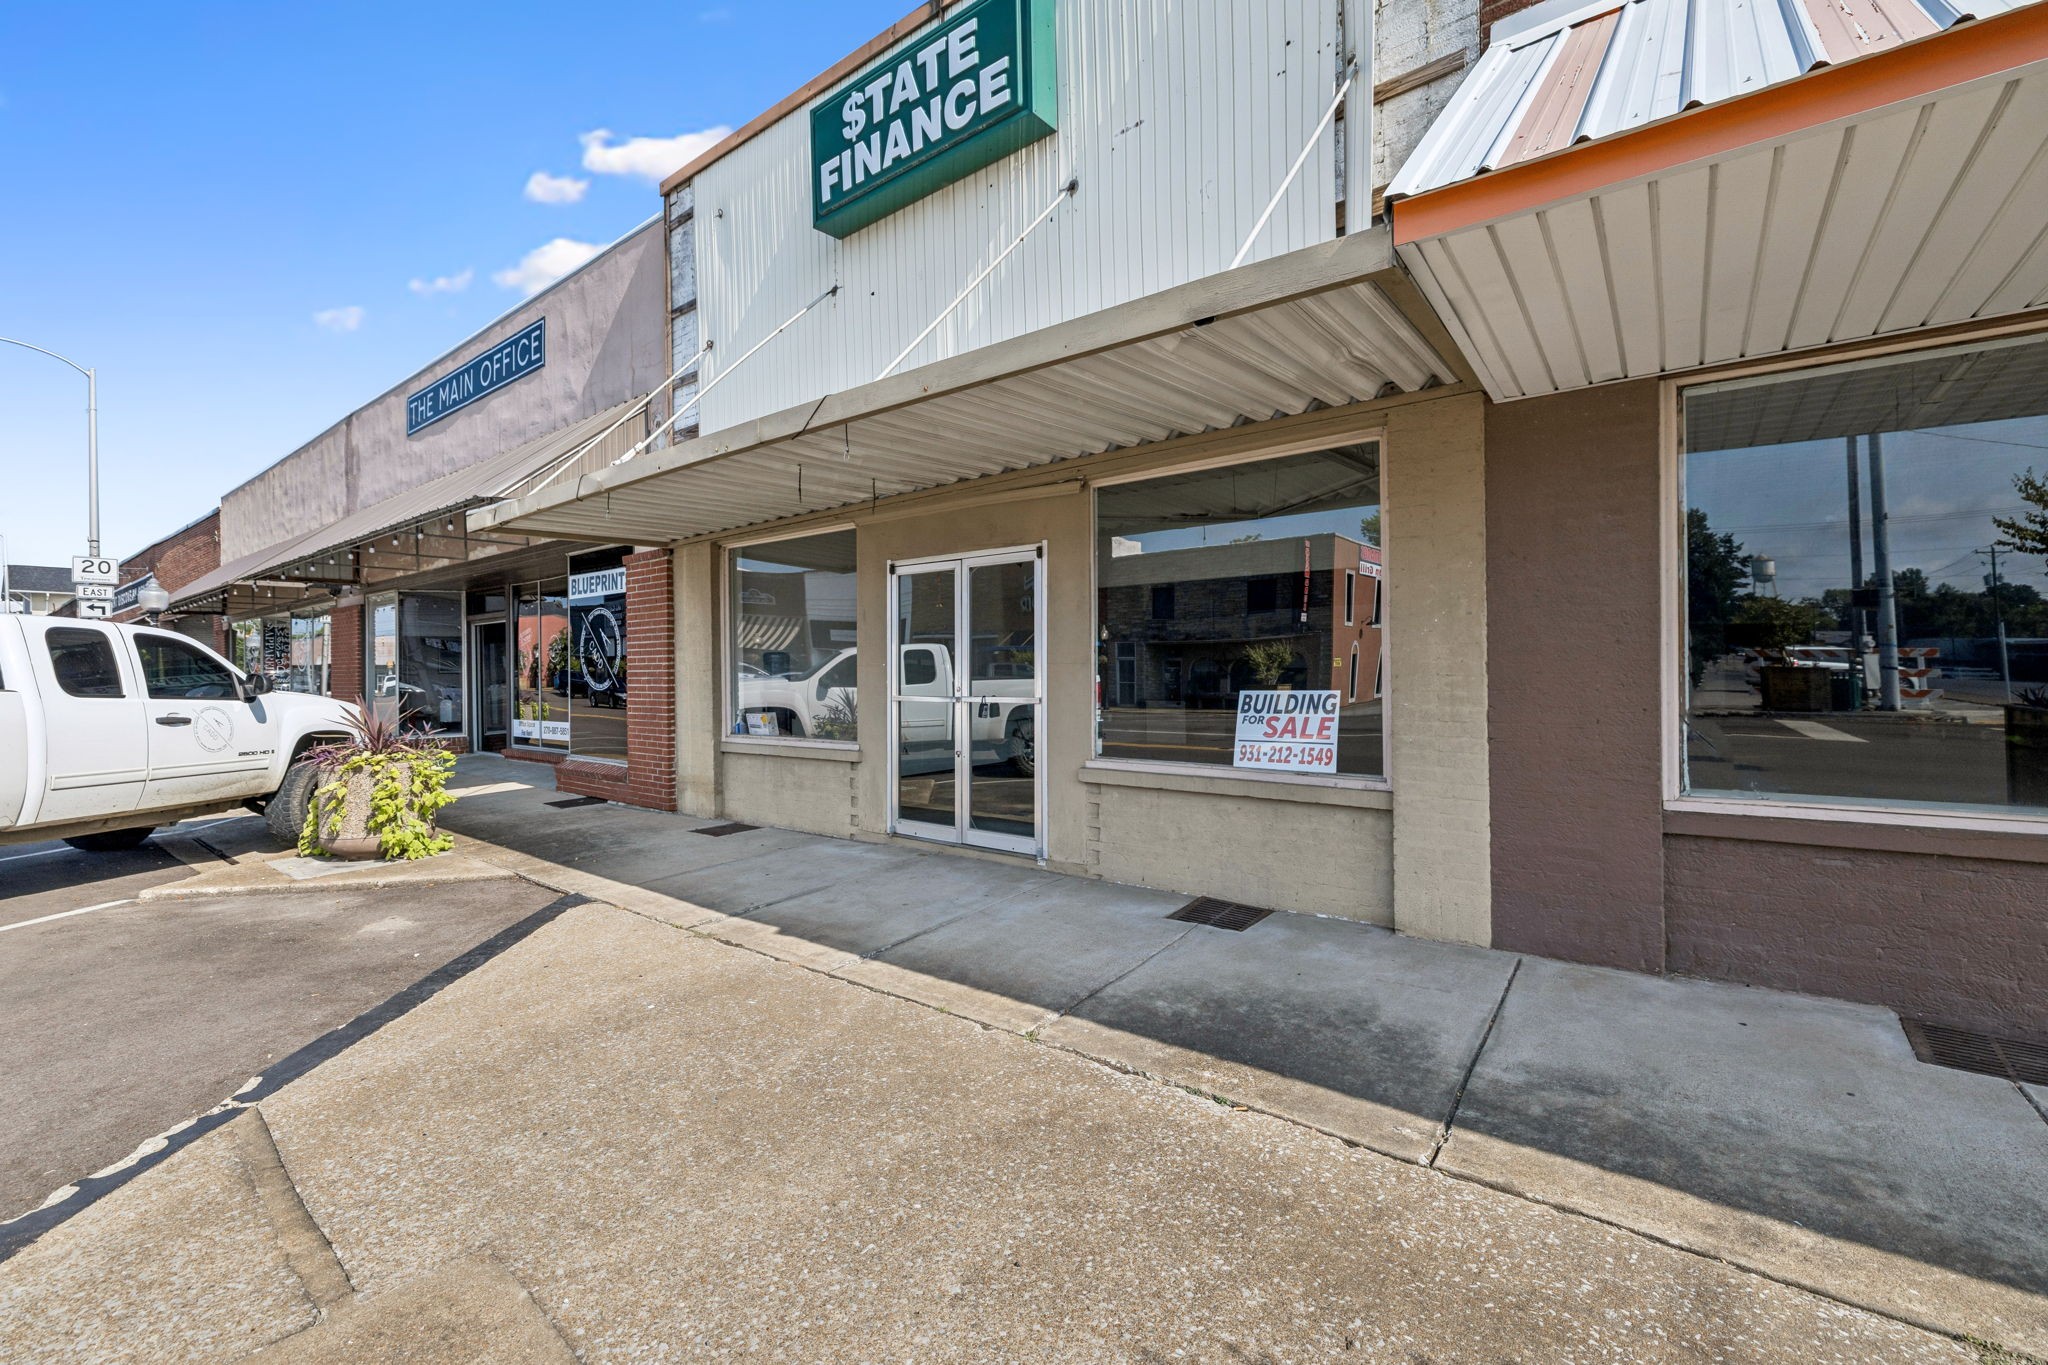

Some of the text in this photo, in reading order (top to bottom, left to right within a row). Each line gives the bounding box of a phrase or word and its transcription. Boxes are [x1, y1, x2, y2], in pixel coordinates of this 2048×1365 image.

[842, 17, 979, 142] $TATE
[820, 56, 1011, 204] FINANCE
[410, 330, 541, 425] THE MAIN OFFICE
[81, 560, 111, 574] 20
[83, 587, 107, 597] EAST
[571, 572, 625, 595] BLUEPRINT
[1240, 693, 1338, 715] BUILDING
[1241, 715, 1336, 740] FOR SALE
[1239, 744, 1334, 767] 931-212-1549
